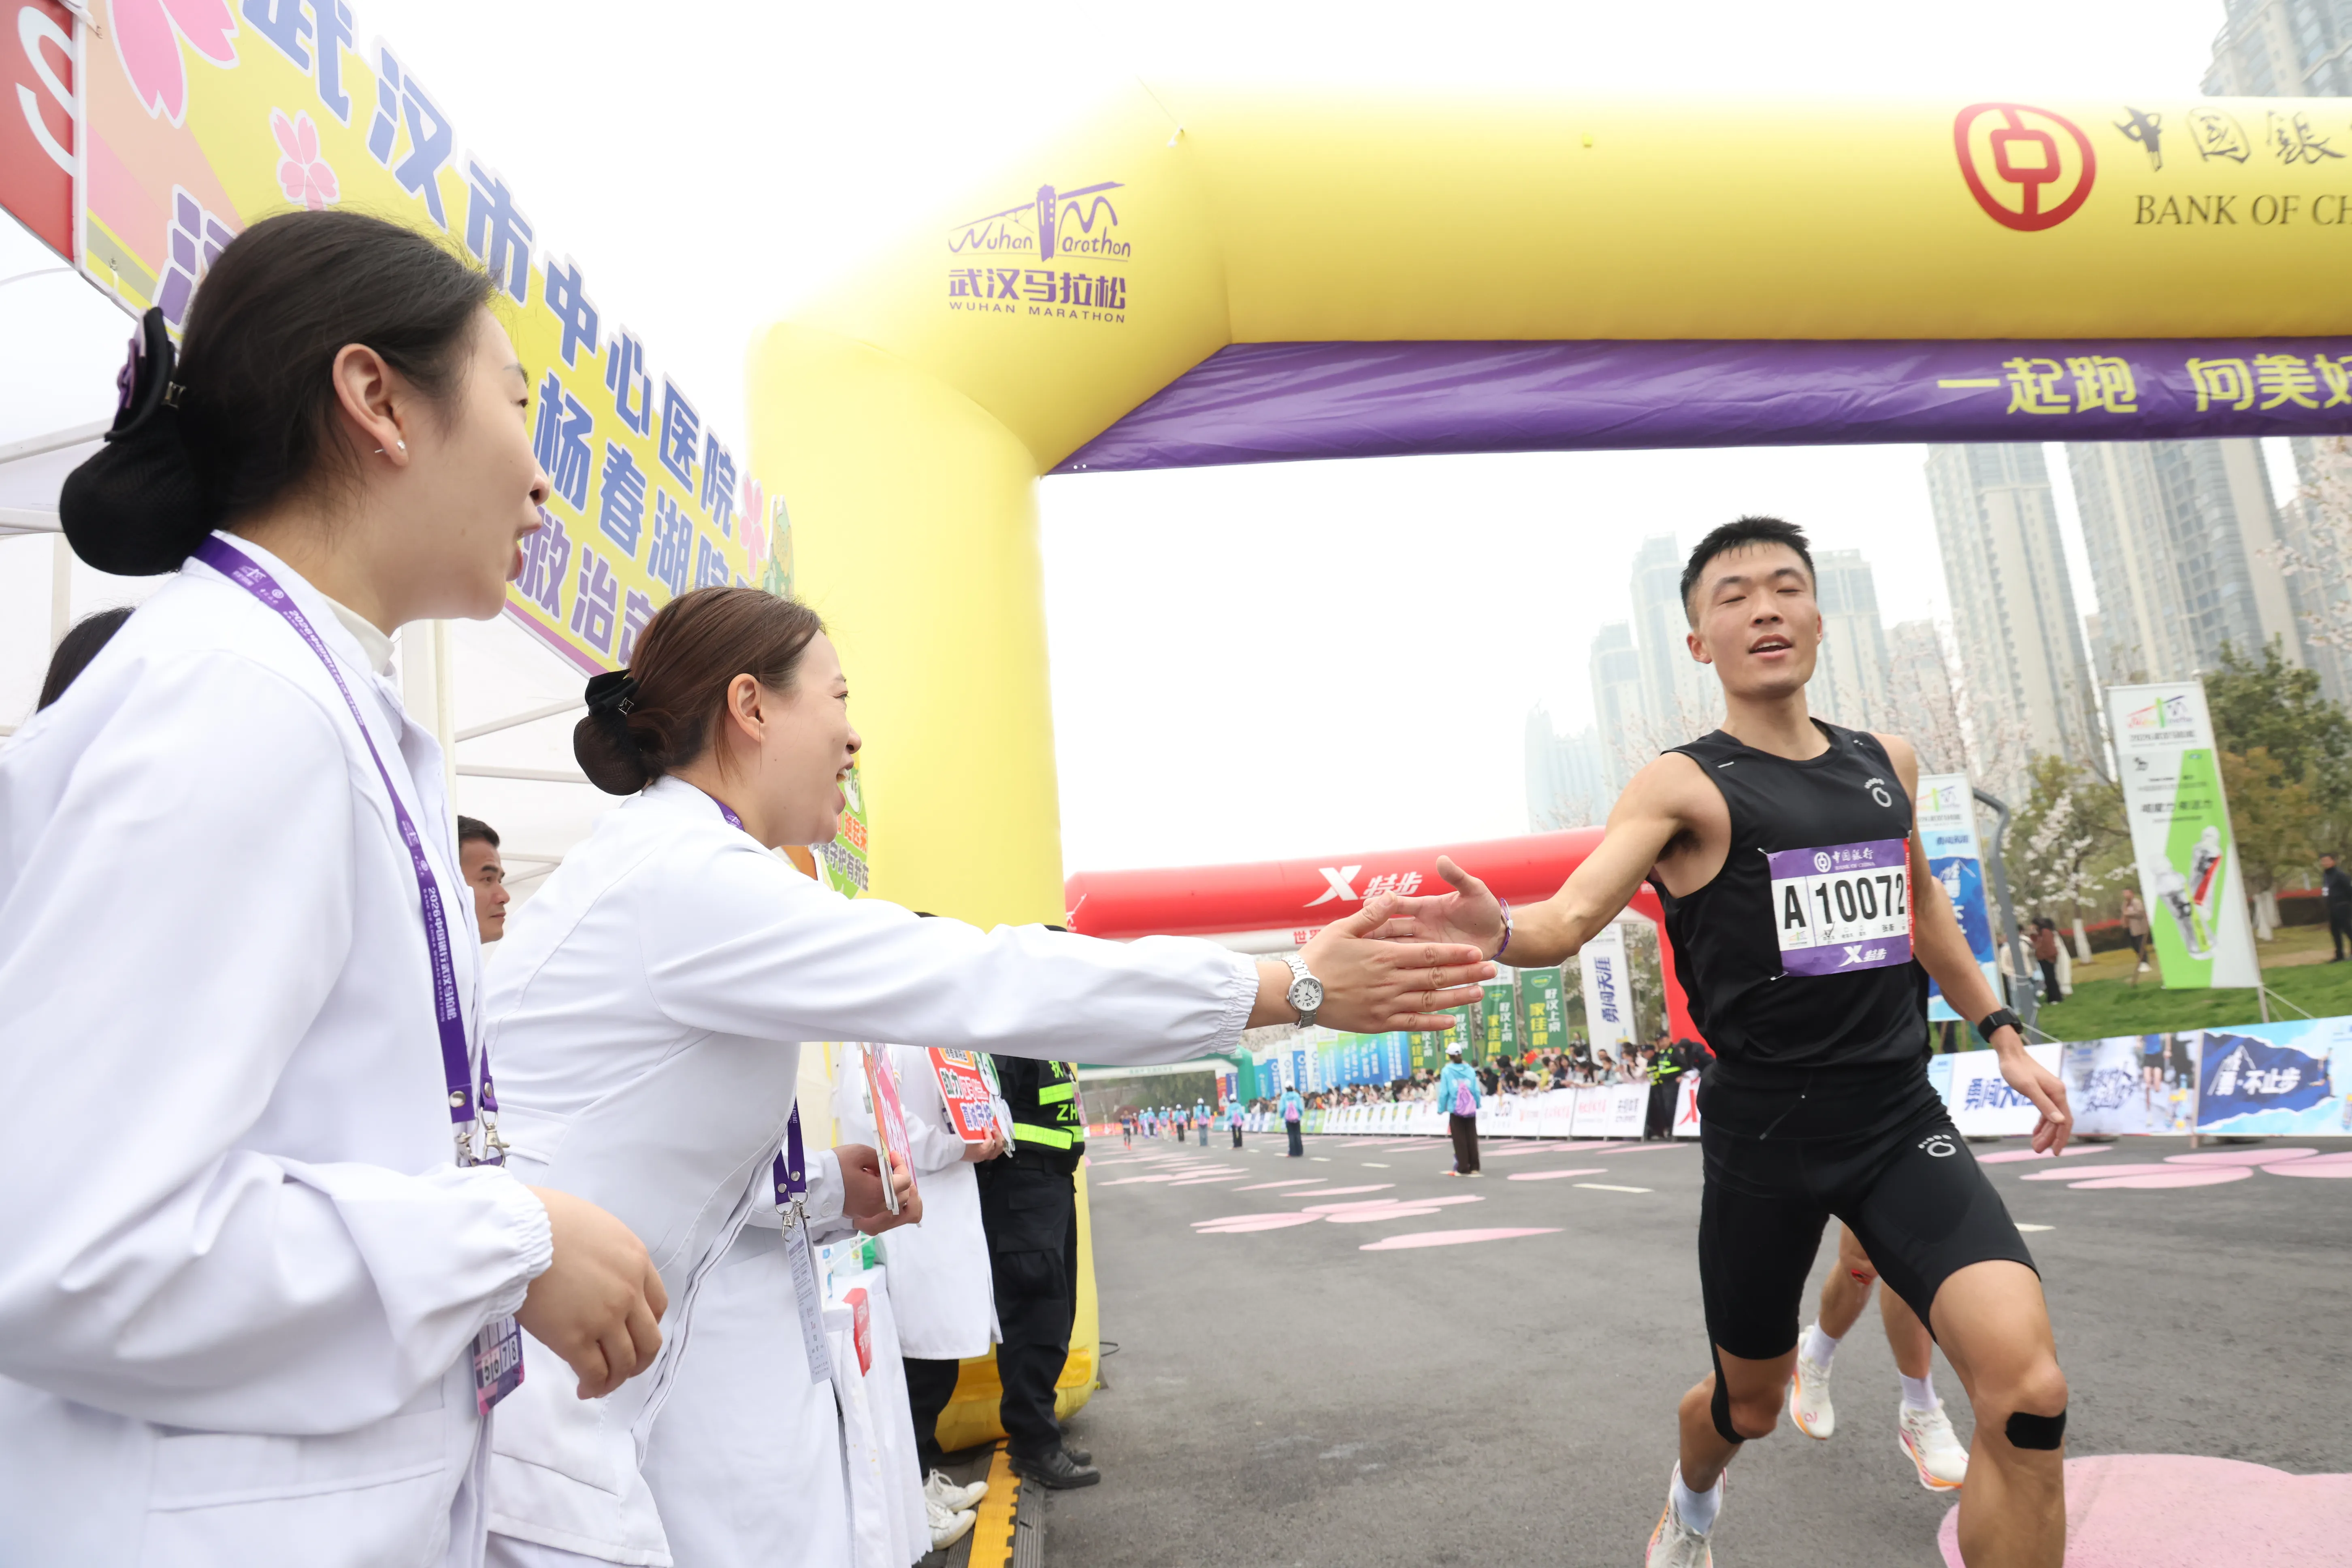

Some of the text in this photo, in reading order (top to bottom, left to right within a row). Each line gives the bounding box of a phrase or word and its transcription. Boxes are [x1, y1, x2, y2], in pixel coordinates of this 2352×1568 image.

[2134, 194, 2239, 226] BANK
[2252, 194, 2301, 226] OF
[948, 268, 1126, 309] 武汉马拉松
[950, 301, 1125, 324] WUHAN MARATHON
[1938, 355, 2138, 414] 一起跑
[1784, 885, 1807, 929] A
[1815, 873, 1905, 924] 10072
[1964, 1077, 2034, 1111] 勇闯天
